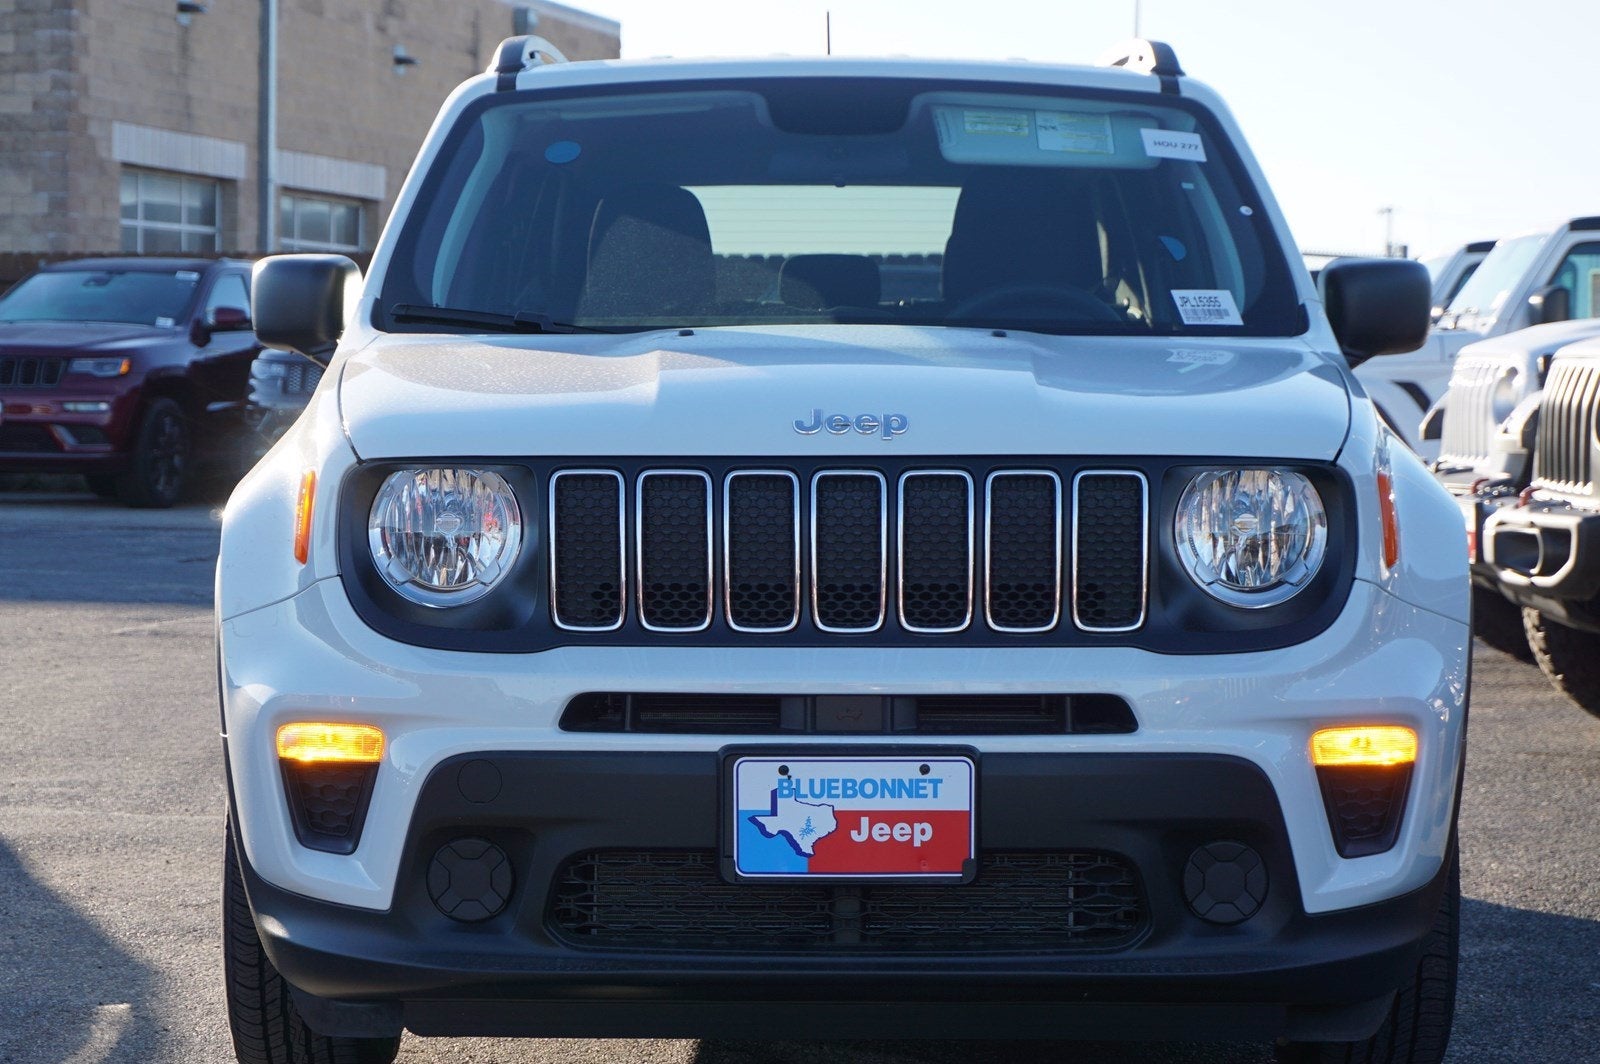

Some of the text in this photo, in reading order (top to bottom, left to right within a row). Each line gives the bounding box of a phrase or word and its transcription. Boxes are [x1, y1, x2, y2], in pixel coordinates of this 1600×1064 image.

[792, 408, 909, 440] Jeep
[777, 777, 943, 799] BLUEBONNET
[850, 816, 933, 847] Jeep
